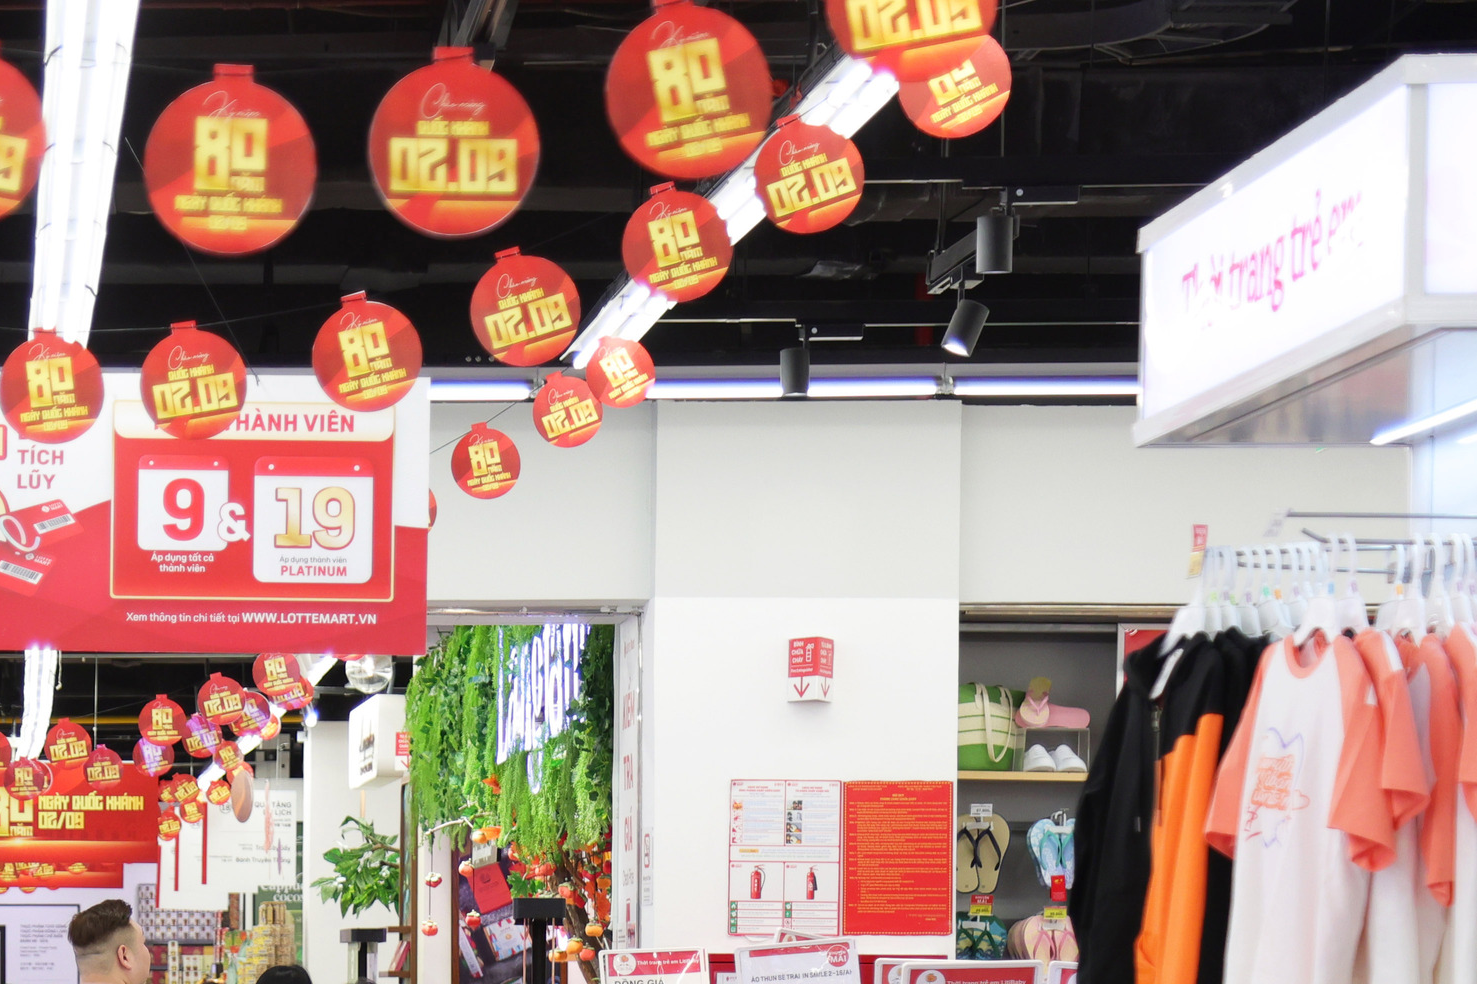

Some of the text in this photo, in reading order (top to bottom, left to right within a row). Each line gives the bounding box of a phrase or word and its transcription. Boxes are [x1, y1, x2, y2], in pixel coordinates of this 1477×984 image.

[648, 37, 727, 123] 80
[194, 116, 269, 191] 80
[389, 137, 518, 193] 02.09
[766, 157, 857, 217] 02.09
[648, 210, 700, 268] 80
[1229, 236, 1285, 312] trang
[484, 293, 572, 350] 02.09
[338, 321, 389, 378] 80
[26, 357, 74, 408] 80
[152, 372, 238, 420] 02.09
[304, 410, 354, 432] VIÊN
[541, 398, 599, 439] 02.09
[17, 442, 64, 465] TÍCH
[468, 440, 501, 477] 80
[17, 470, 55, 489] LŨY
[163, 478, 356, 550] 9 & 19
[151, 551, 164, 563] Áp
[166, 553, 187, 563] dụng
[159, 564, 205, 572] thành viên
[280, 566, 347, 576] PLATINUM
[126, 612, 377, 625] Xem thông tin chi tiết tại WWW.LOTTEMART.VN
[623, 753, 633, 790] TRA
[38, 790, 144, 811] NGÀY QUỐC KHÁNH
[38, 812, 84, 829] 02/09
